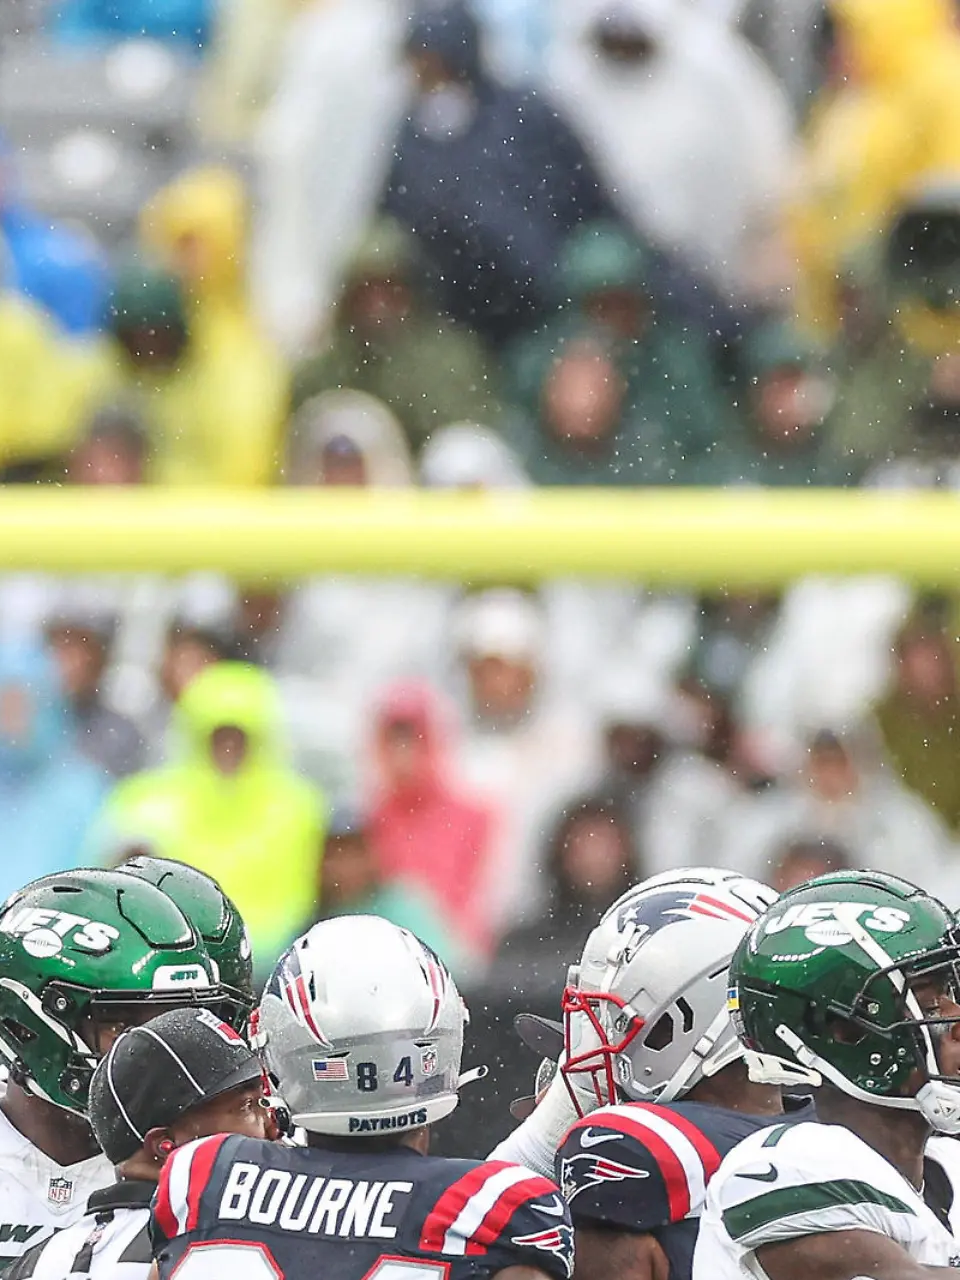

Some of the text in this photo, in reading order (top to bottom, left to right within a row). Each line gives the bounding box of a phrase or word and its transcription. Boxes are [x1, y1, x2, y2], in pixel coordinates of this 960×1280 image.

[0, 907, 120, 950] JETS
[765, 902, 910, 935] JETS
[356, 1056, 413, 1092] 8 4
[348, 1107, 428, 1132] PATRIOTS
[218, 1161, 414, 1239] BOURNE
